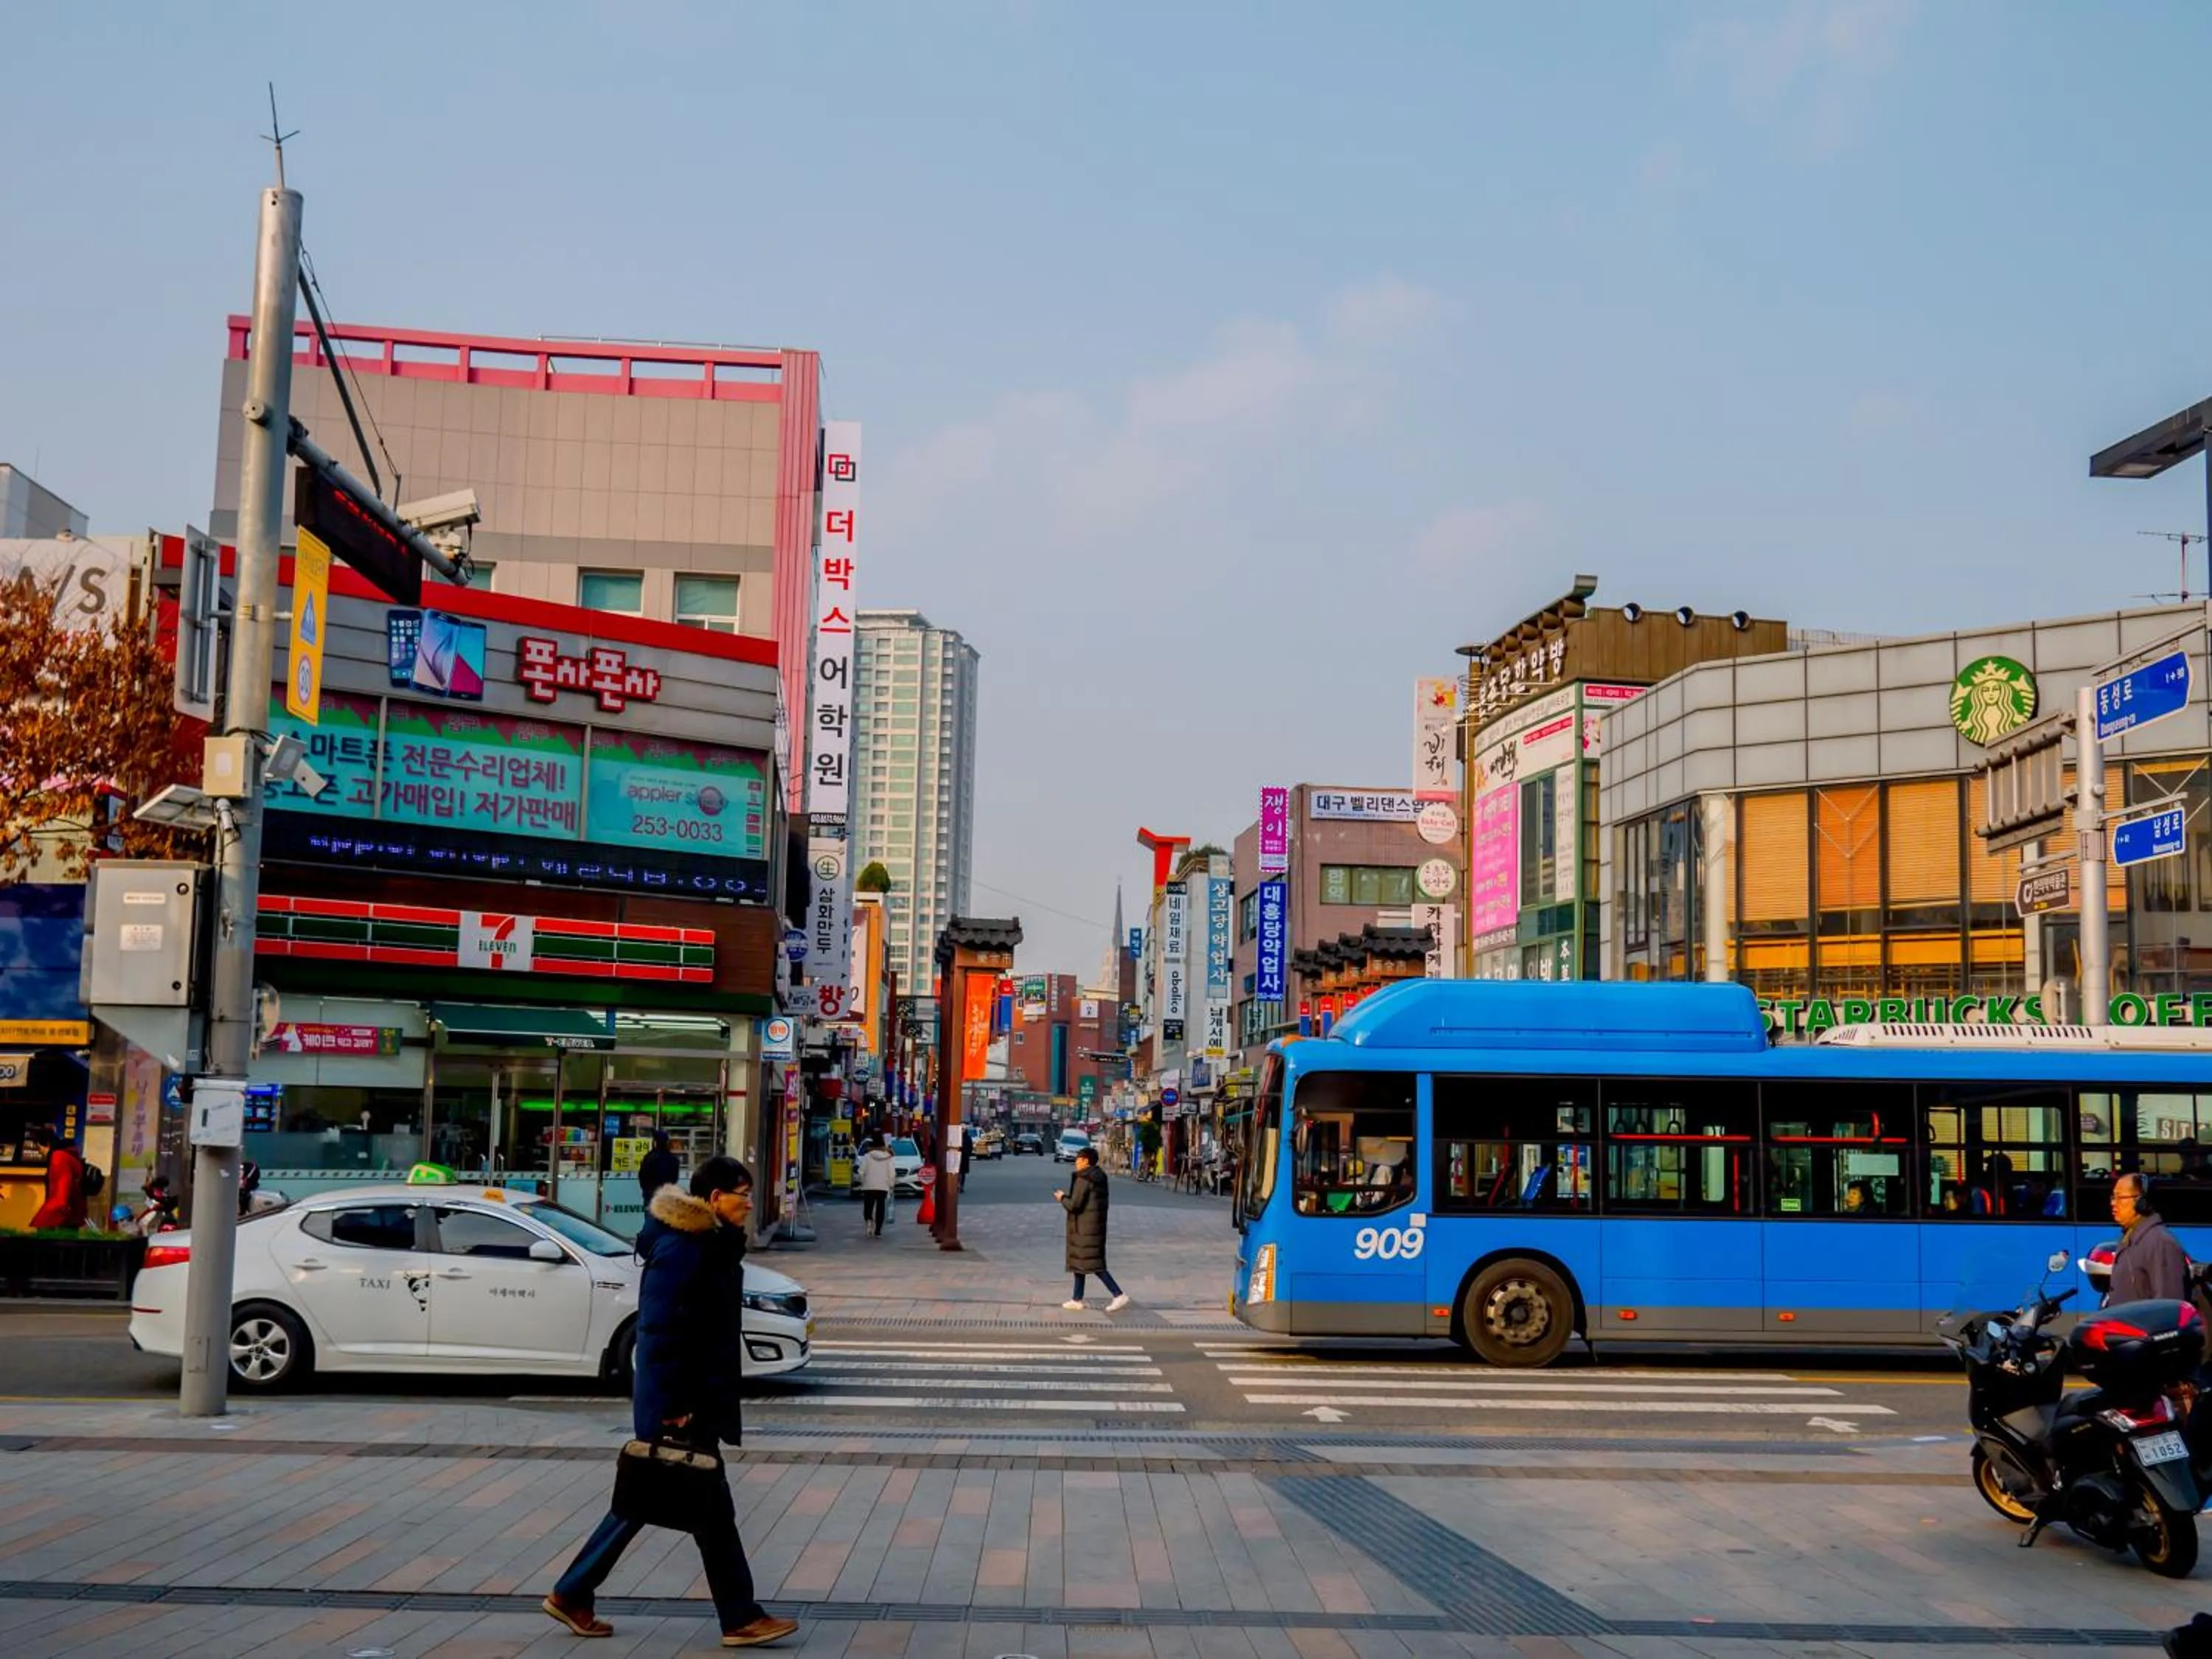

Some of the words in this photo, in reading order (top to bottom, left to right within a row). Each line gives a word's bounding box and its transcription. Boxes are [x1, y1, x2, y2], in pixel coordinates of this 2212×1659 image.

[2100, 678, 2133, 715] 동성로
[401, 743, 566, 793] 전문수리업체!
[346, 776, 465, 819] 고가매입!
[474, 790, 577, 832] 저가판매
[1316, 795, 1346, 811] 대구
[632, 814, 723, 843] 253-0033
[1171, 971, 1182, 1014] abalico
[1756, 995, 2048, 1034] STARBUCKS
[605, 1204, 644, 1214] 7-ELEVE
[1353, 1227, 1425, 1260] 909
[359, 1278, 391, 1290] TAXI
